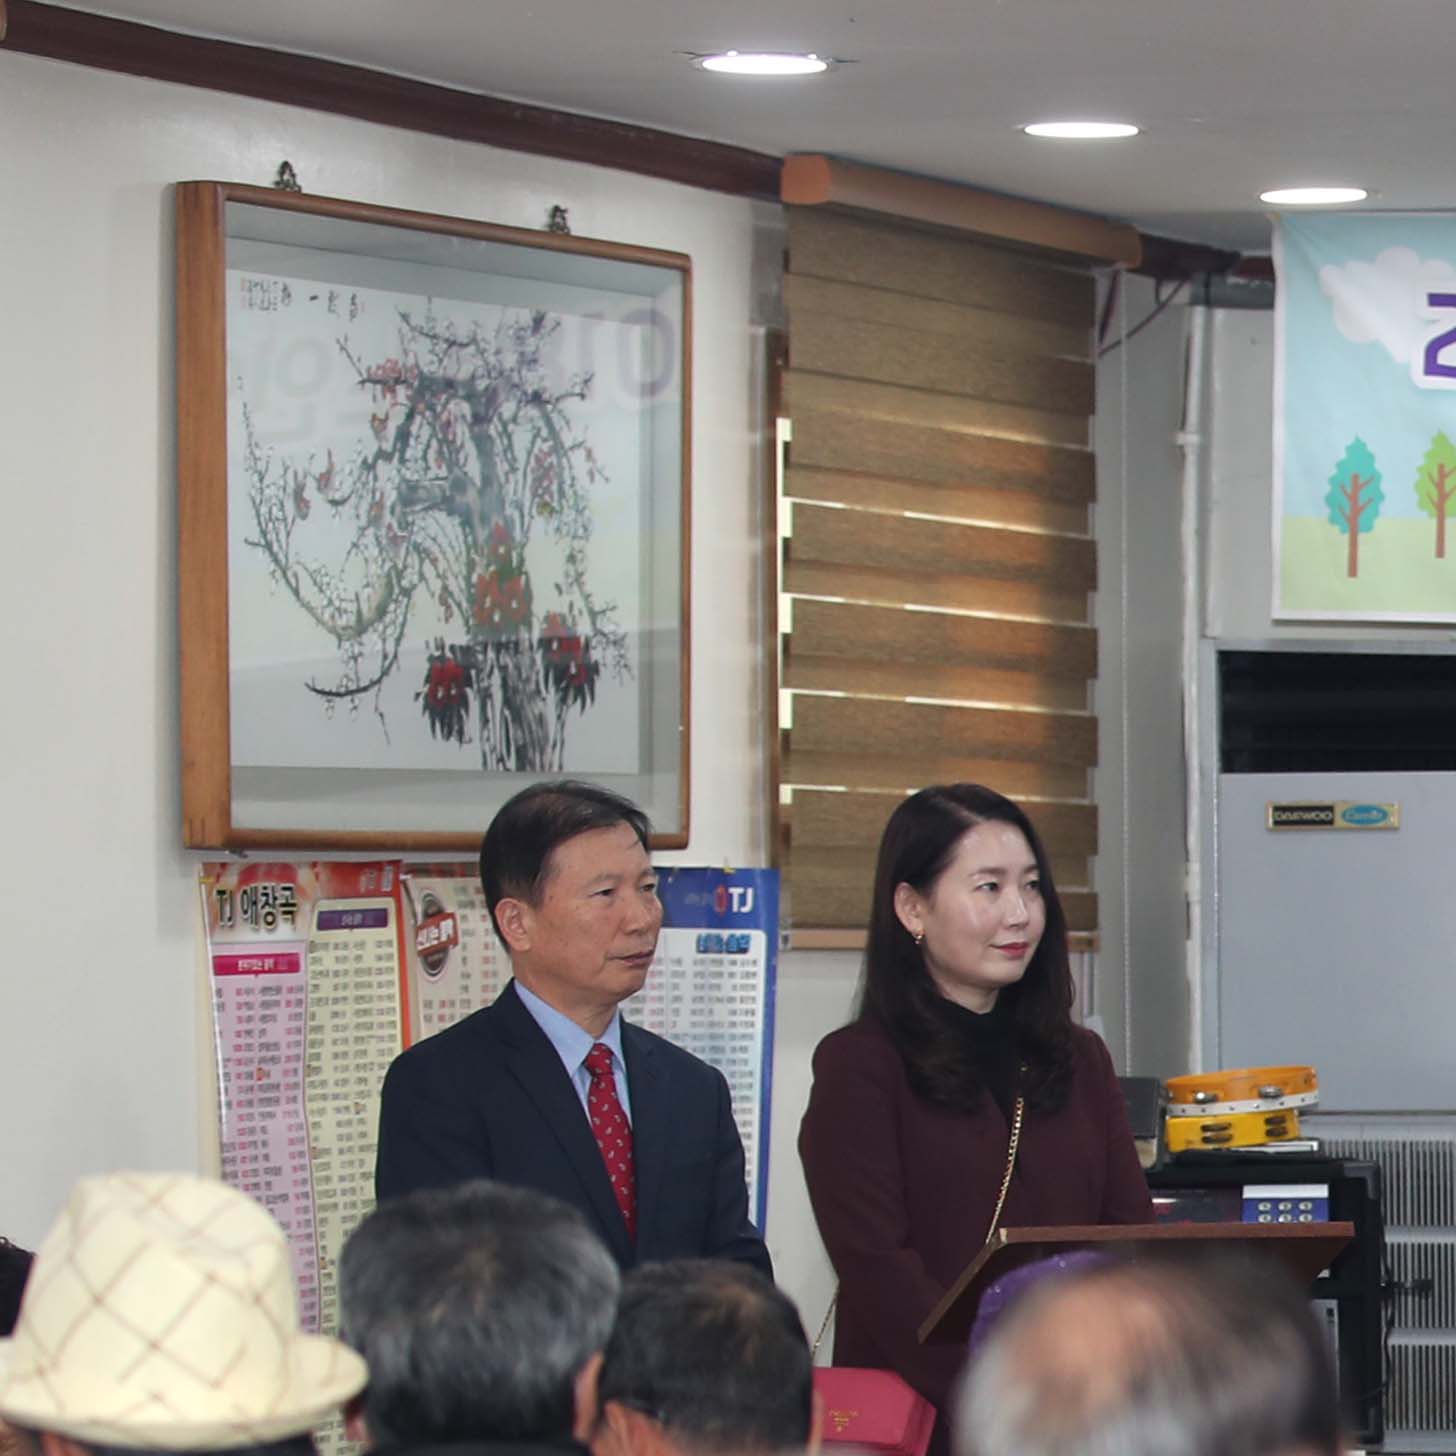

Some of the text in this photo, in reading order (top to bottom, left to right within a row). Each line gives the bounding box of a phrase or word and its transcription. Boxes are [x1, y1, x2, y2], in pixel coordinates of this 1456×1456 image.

[1275, 810, 1333, 821] DAEWOO
[215, 882, 297, 931] TJ 애창곡
[728, 886, 754, 913] TJ
